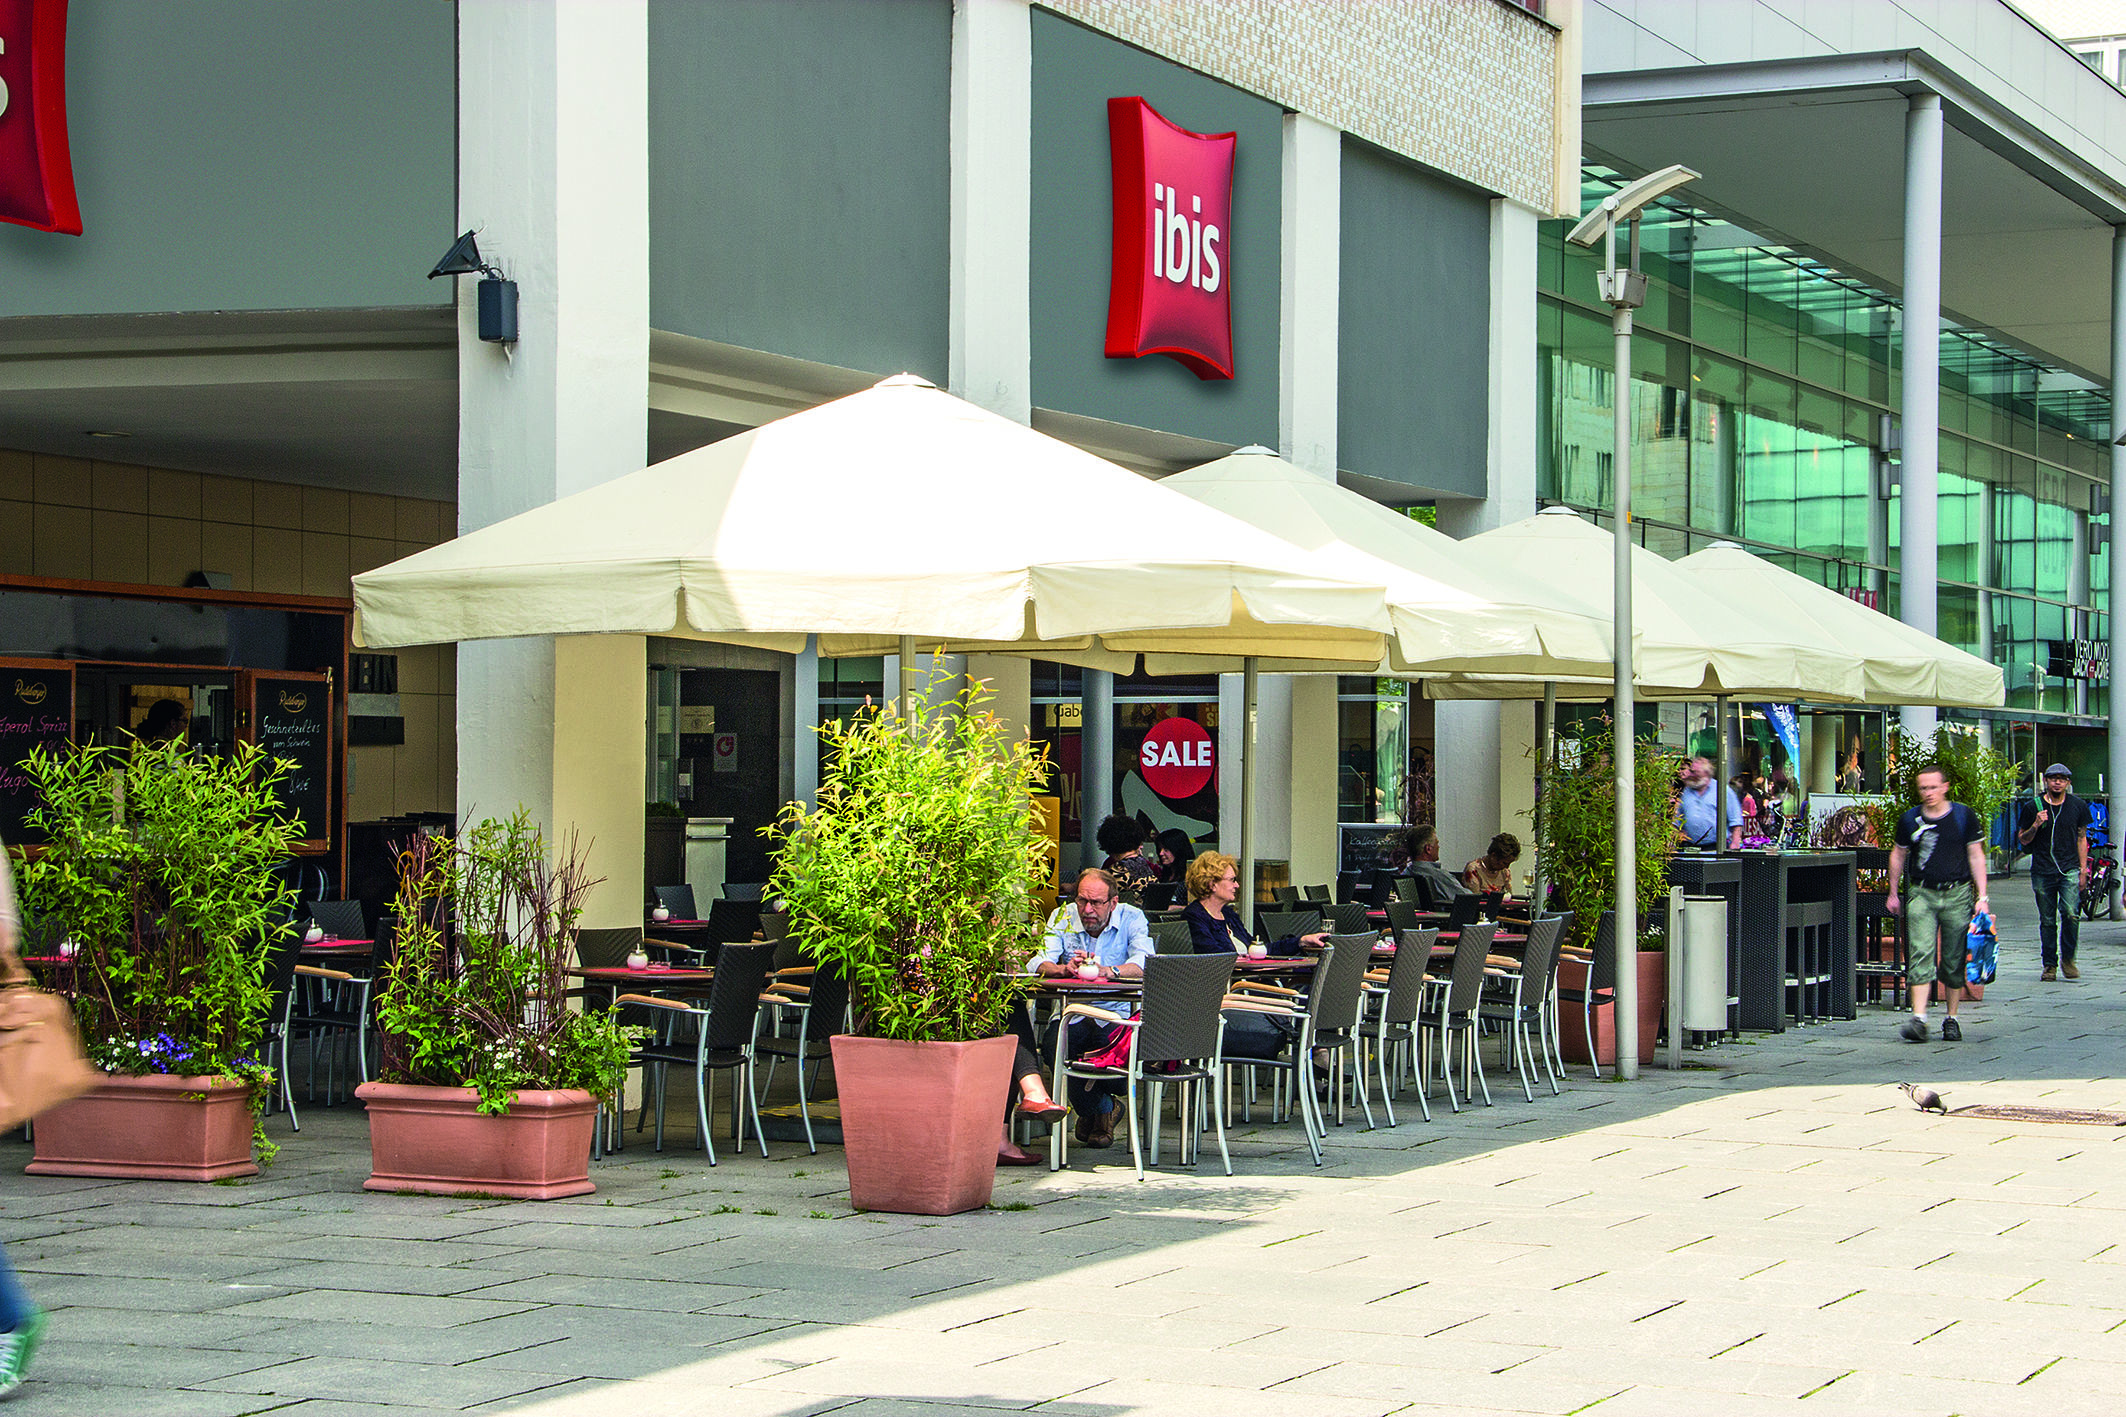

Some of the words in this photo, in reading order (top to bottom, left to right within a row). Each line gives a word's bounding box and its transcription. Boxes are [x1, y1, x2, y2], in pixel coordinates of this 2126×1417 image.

[1154, 182, 1220, 293] ibis
[2093, 641, 2110, 662] MOD
[1054, 703, 1083, 717] Gab
[1141, 740, 1212, 767] SALE
